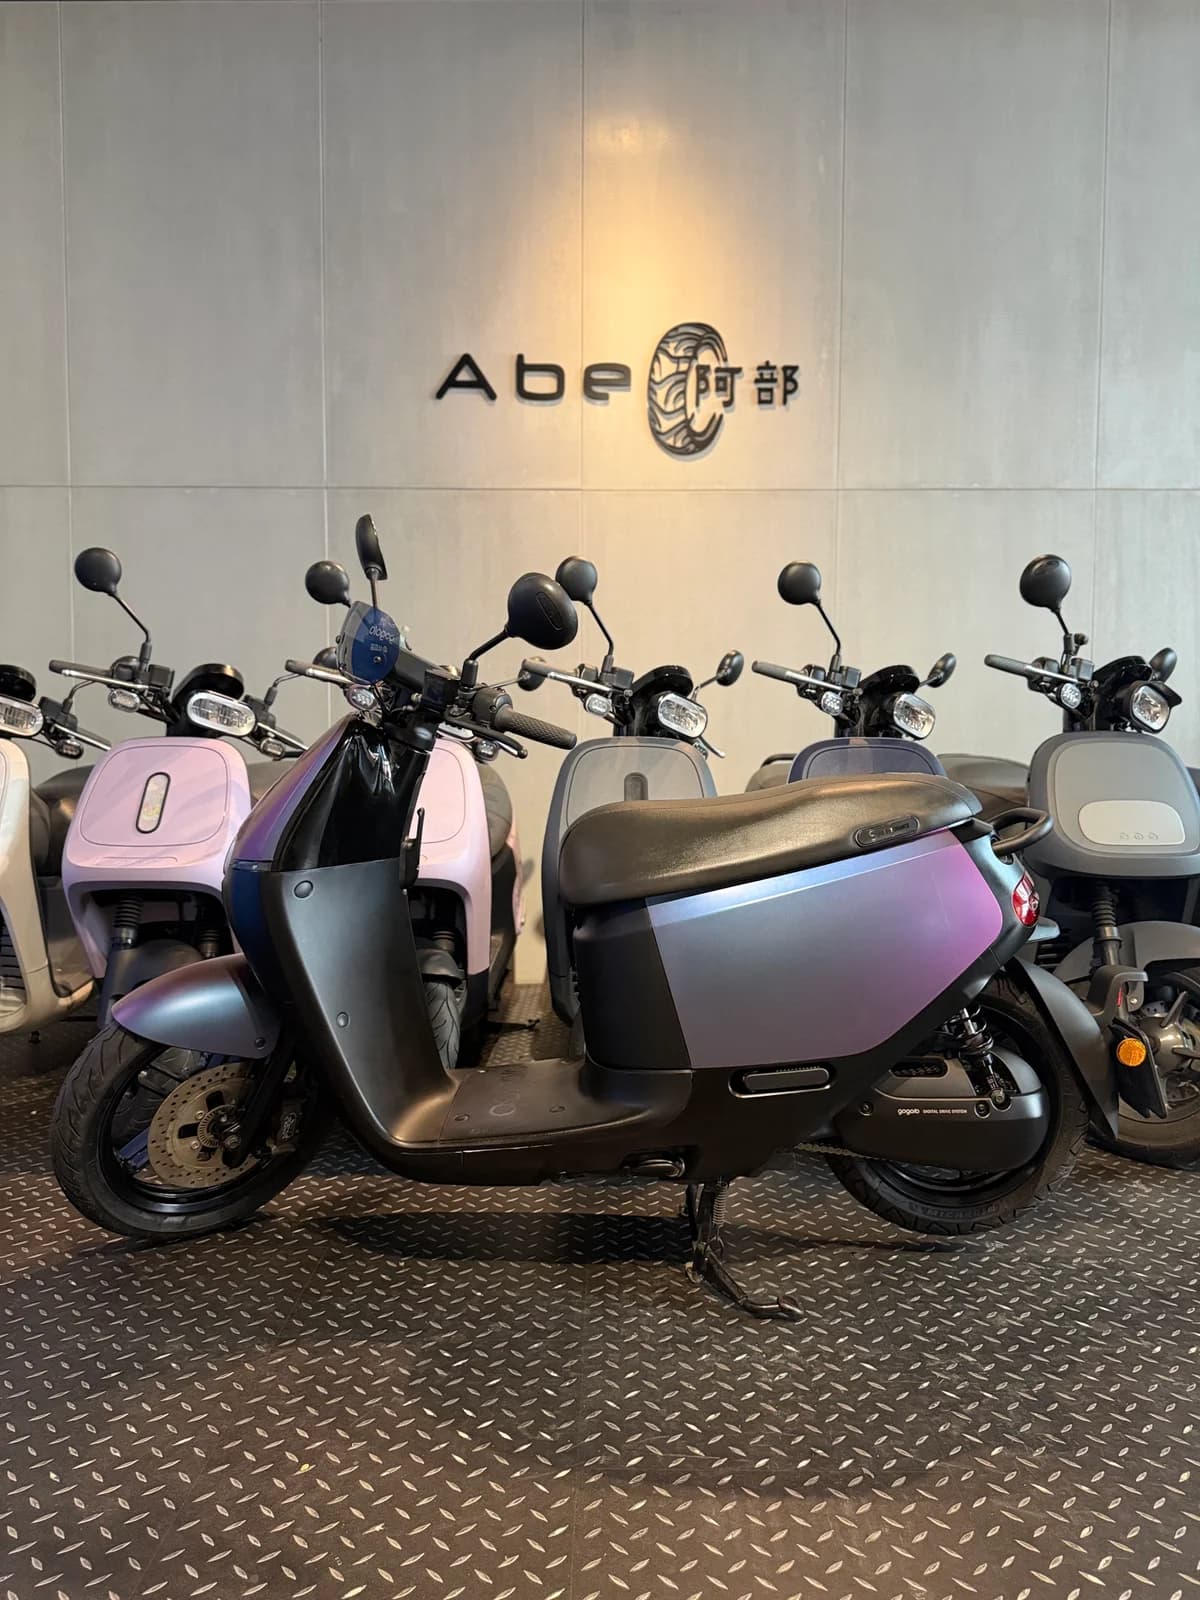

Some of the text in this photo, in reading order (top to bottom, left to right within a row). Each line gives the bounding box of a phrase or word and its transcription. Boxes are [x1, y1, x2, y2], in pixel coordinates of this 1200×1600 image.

[436, 353, 631, 401] Abe
[695, 361, 799, 406] 阿部
[898, 1108, 920, 1116] gogoro
